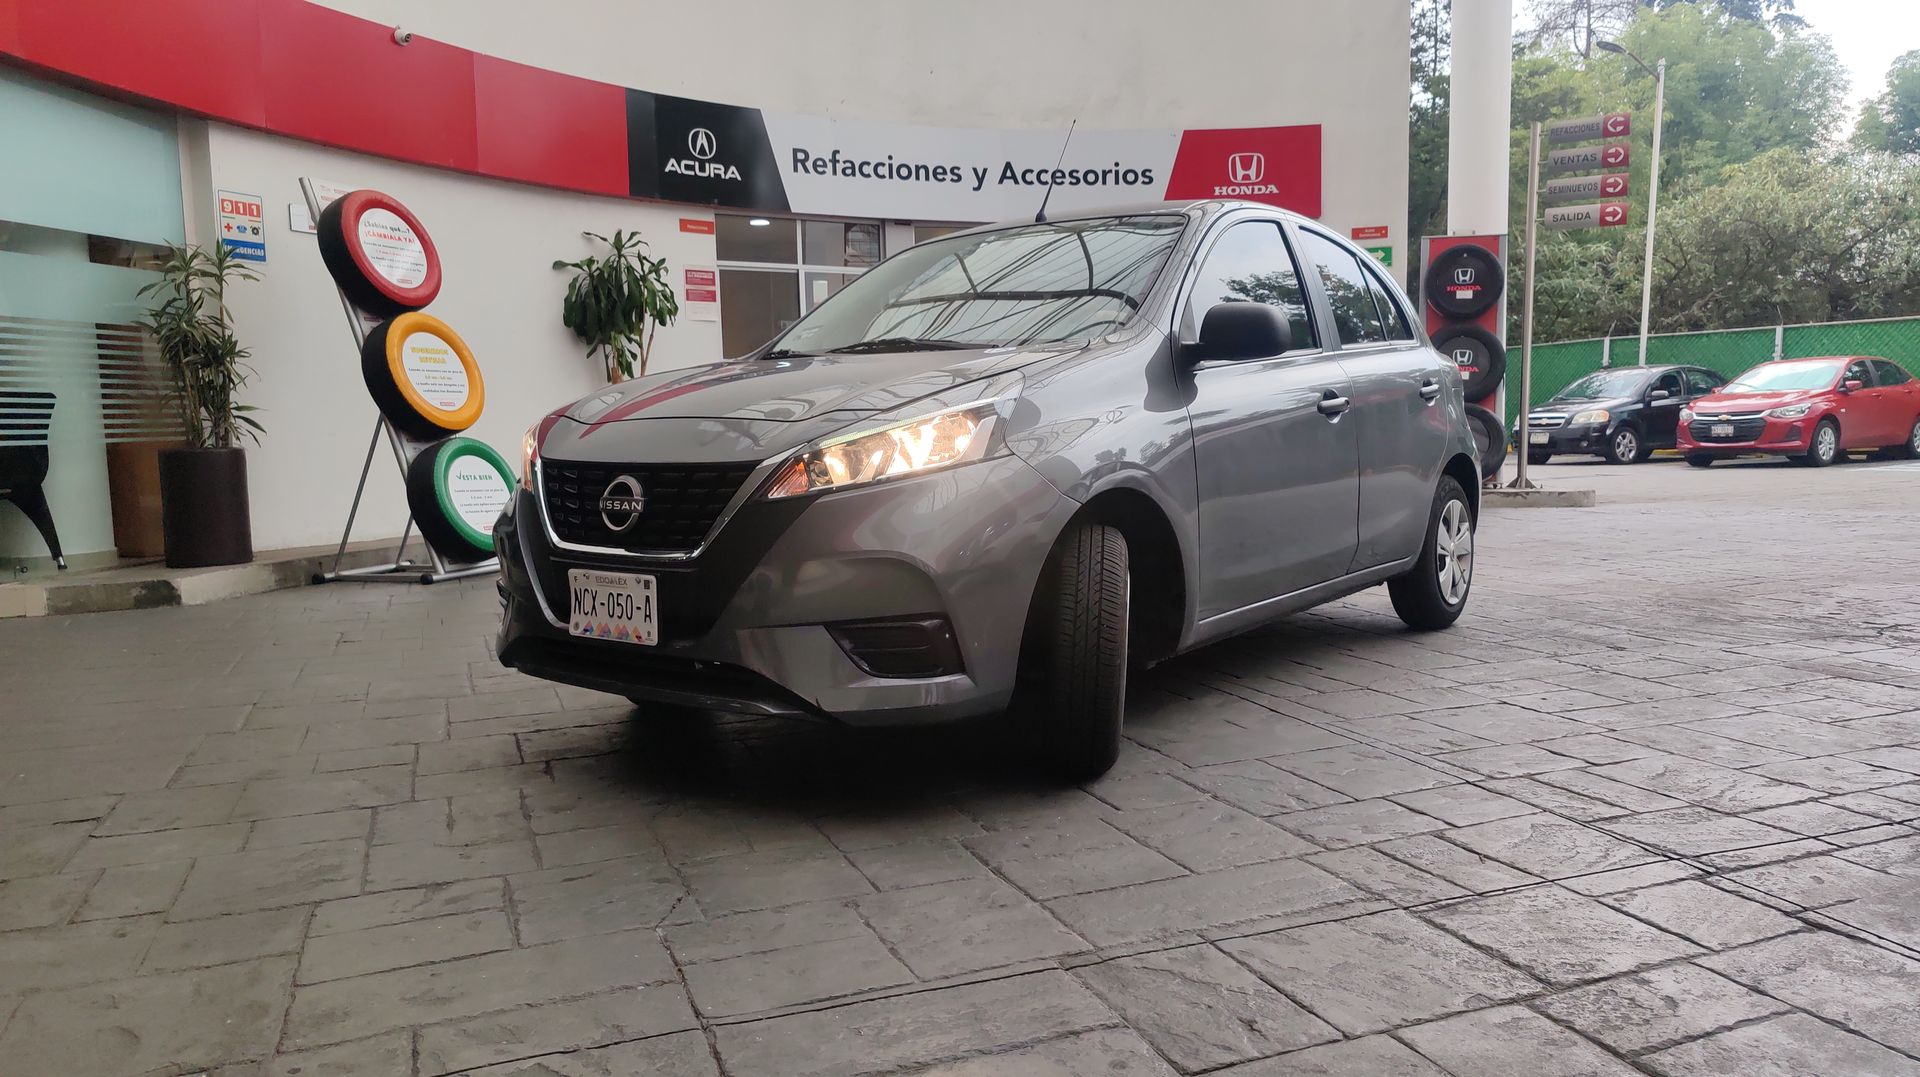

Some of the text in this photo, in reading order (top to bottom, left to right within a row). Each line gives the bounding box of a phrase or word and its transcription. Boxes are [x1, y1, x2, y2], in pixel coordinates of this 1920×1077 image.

[1550, 122, 1600, 136] REFACCIONES
[1552, 153, 1597, 166] VENTAS
[664, 157, 742, 181] ACURA
[792, 147, 1155, 192] Refacciones y Accesorios
[1213, 184, 1280, 196] HONDA
[1548, 182, 1599, 195] SEMINUEVOS
[223, 200, 257, 216] 911
[1552, 212, 1592, 223] SALIDA
[600, 500, 642, 510] NISSAN
[573, 587, 653, 624] NCX-050-A
